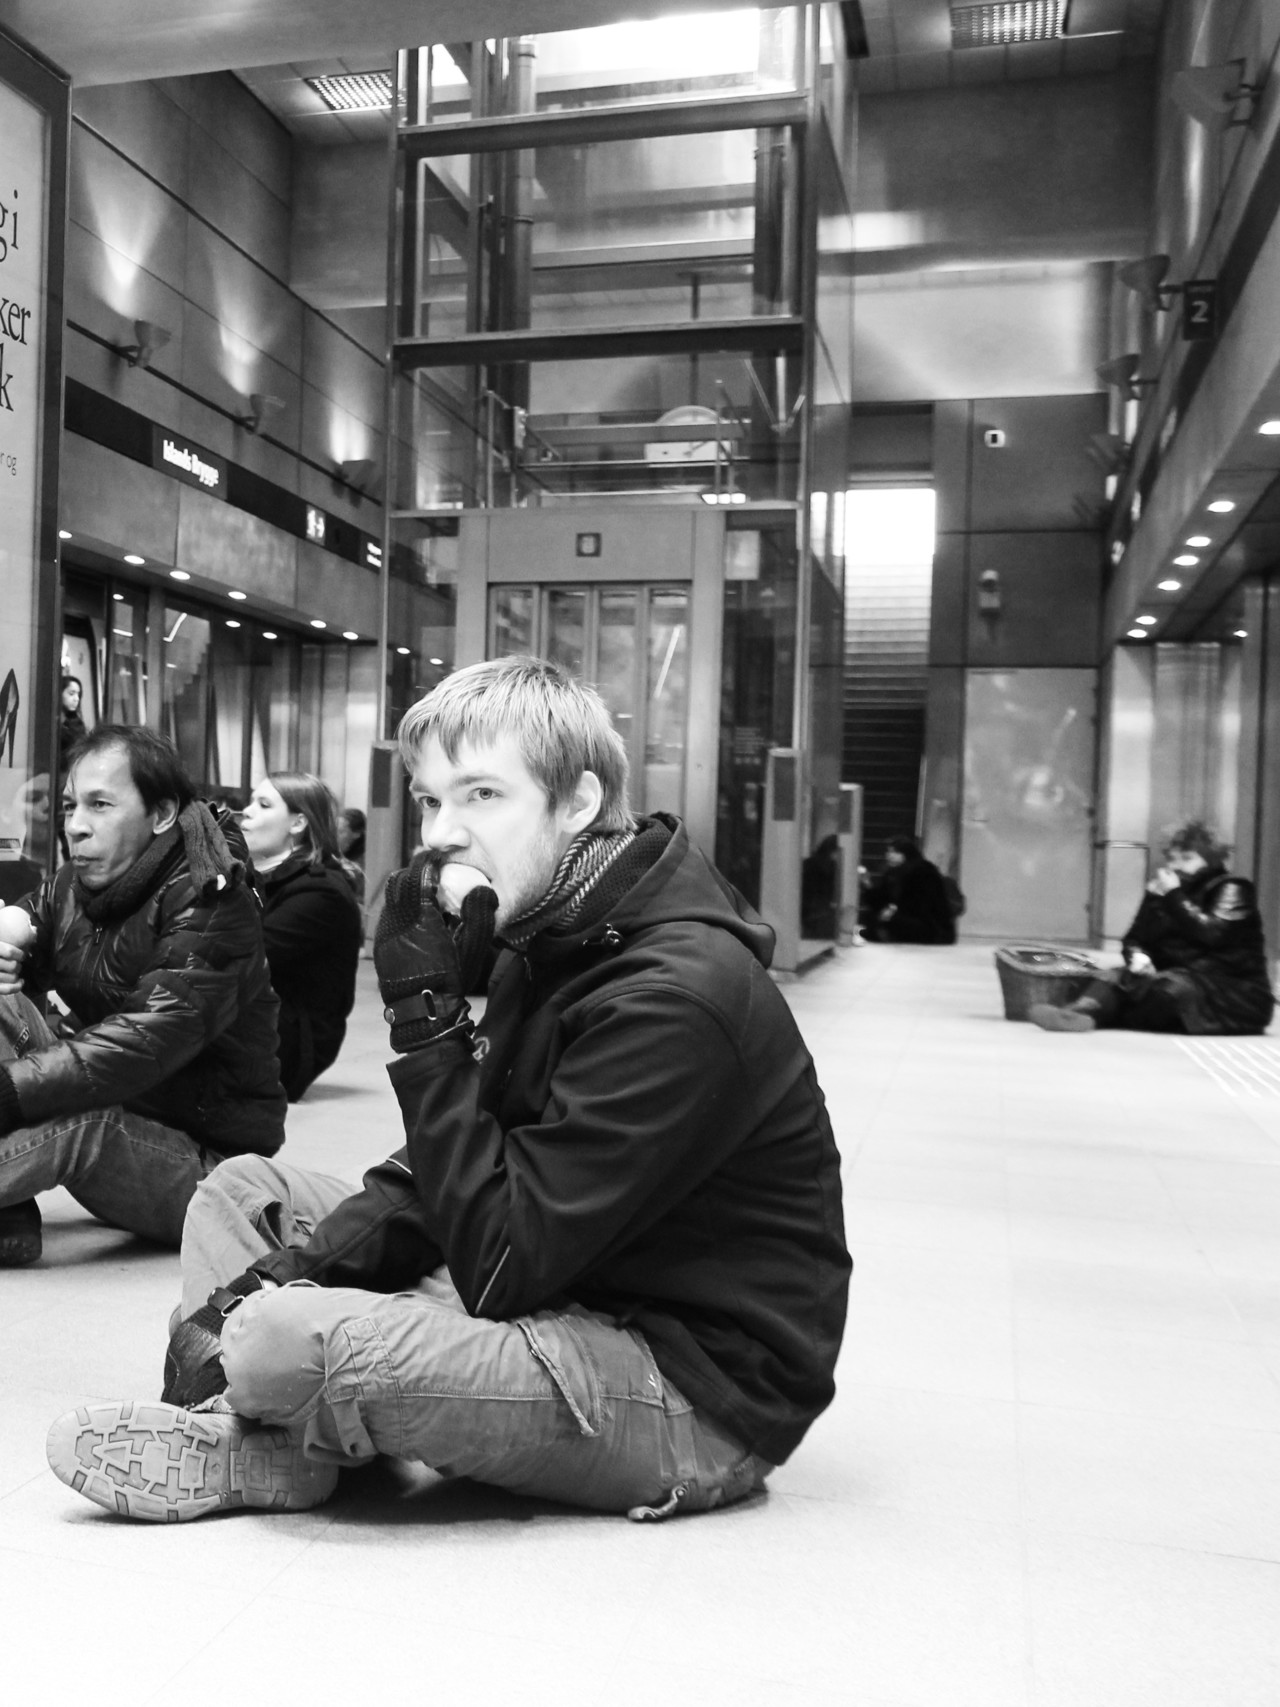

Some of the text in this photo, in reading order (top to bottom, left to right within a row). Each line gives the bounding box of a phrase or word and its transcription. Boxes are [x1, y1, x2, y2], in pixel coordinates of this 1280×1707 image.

[11, 189, 19, 250] i
[1191, 300, 1209, 323] 2
[6, 455, 17, 476] og
